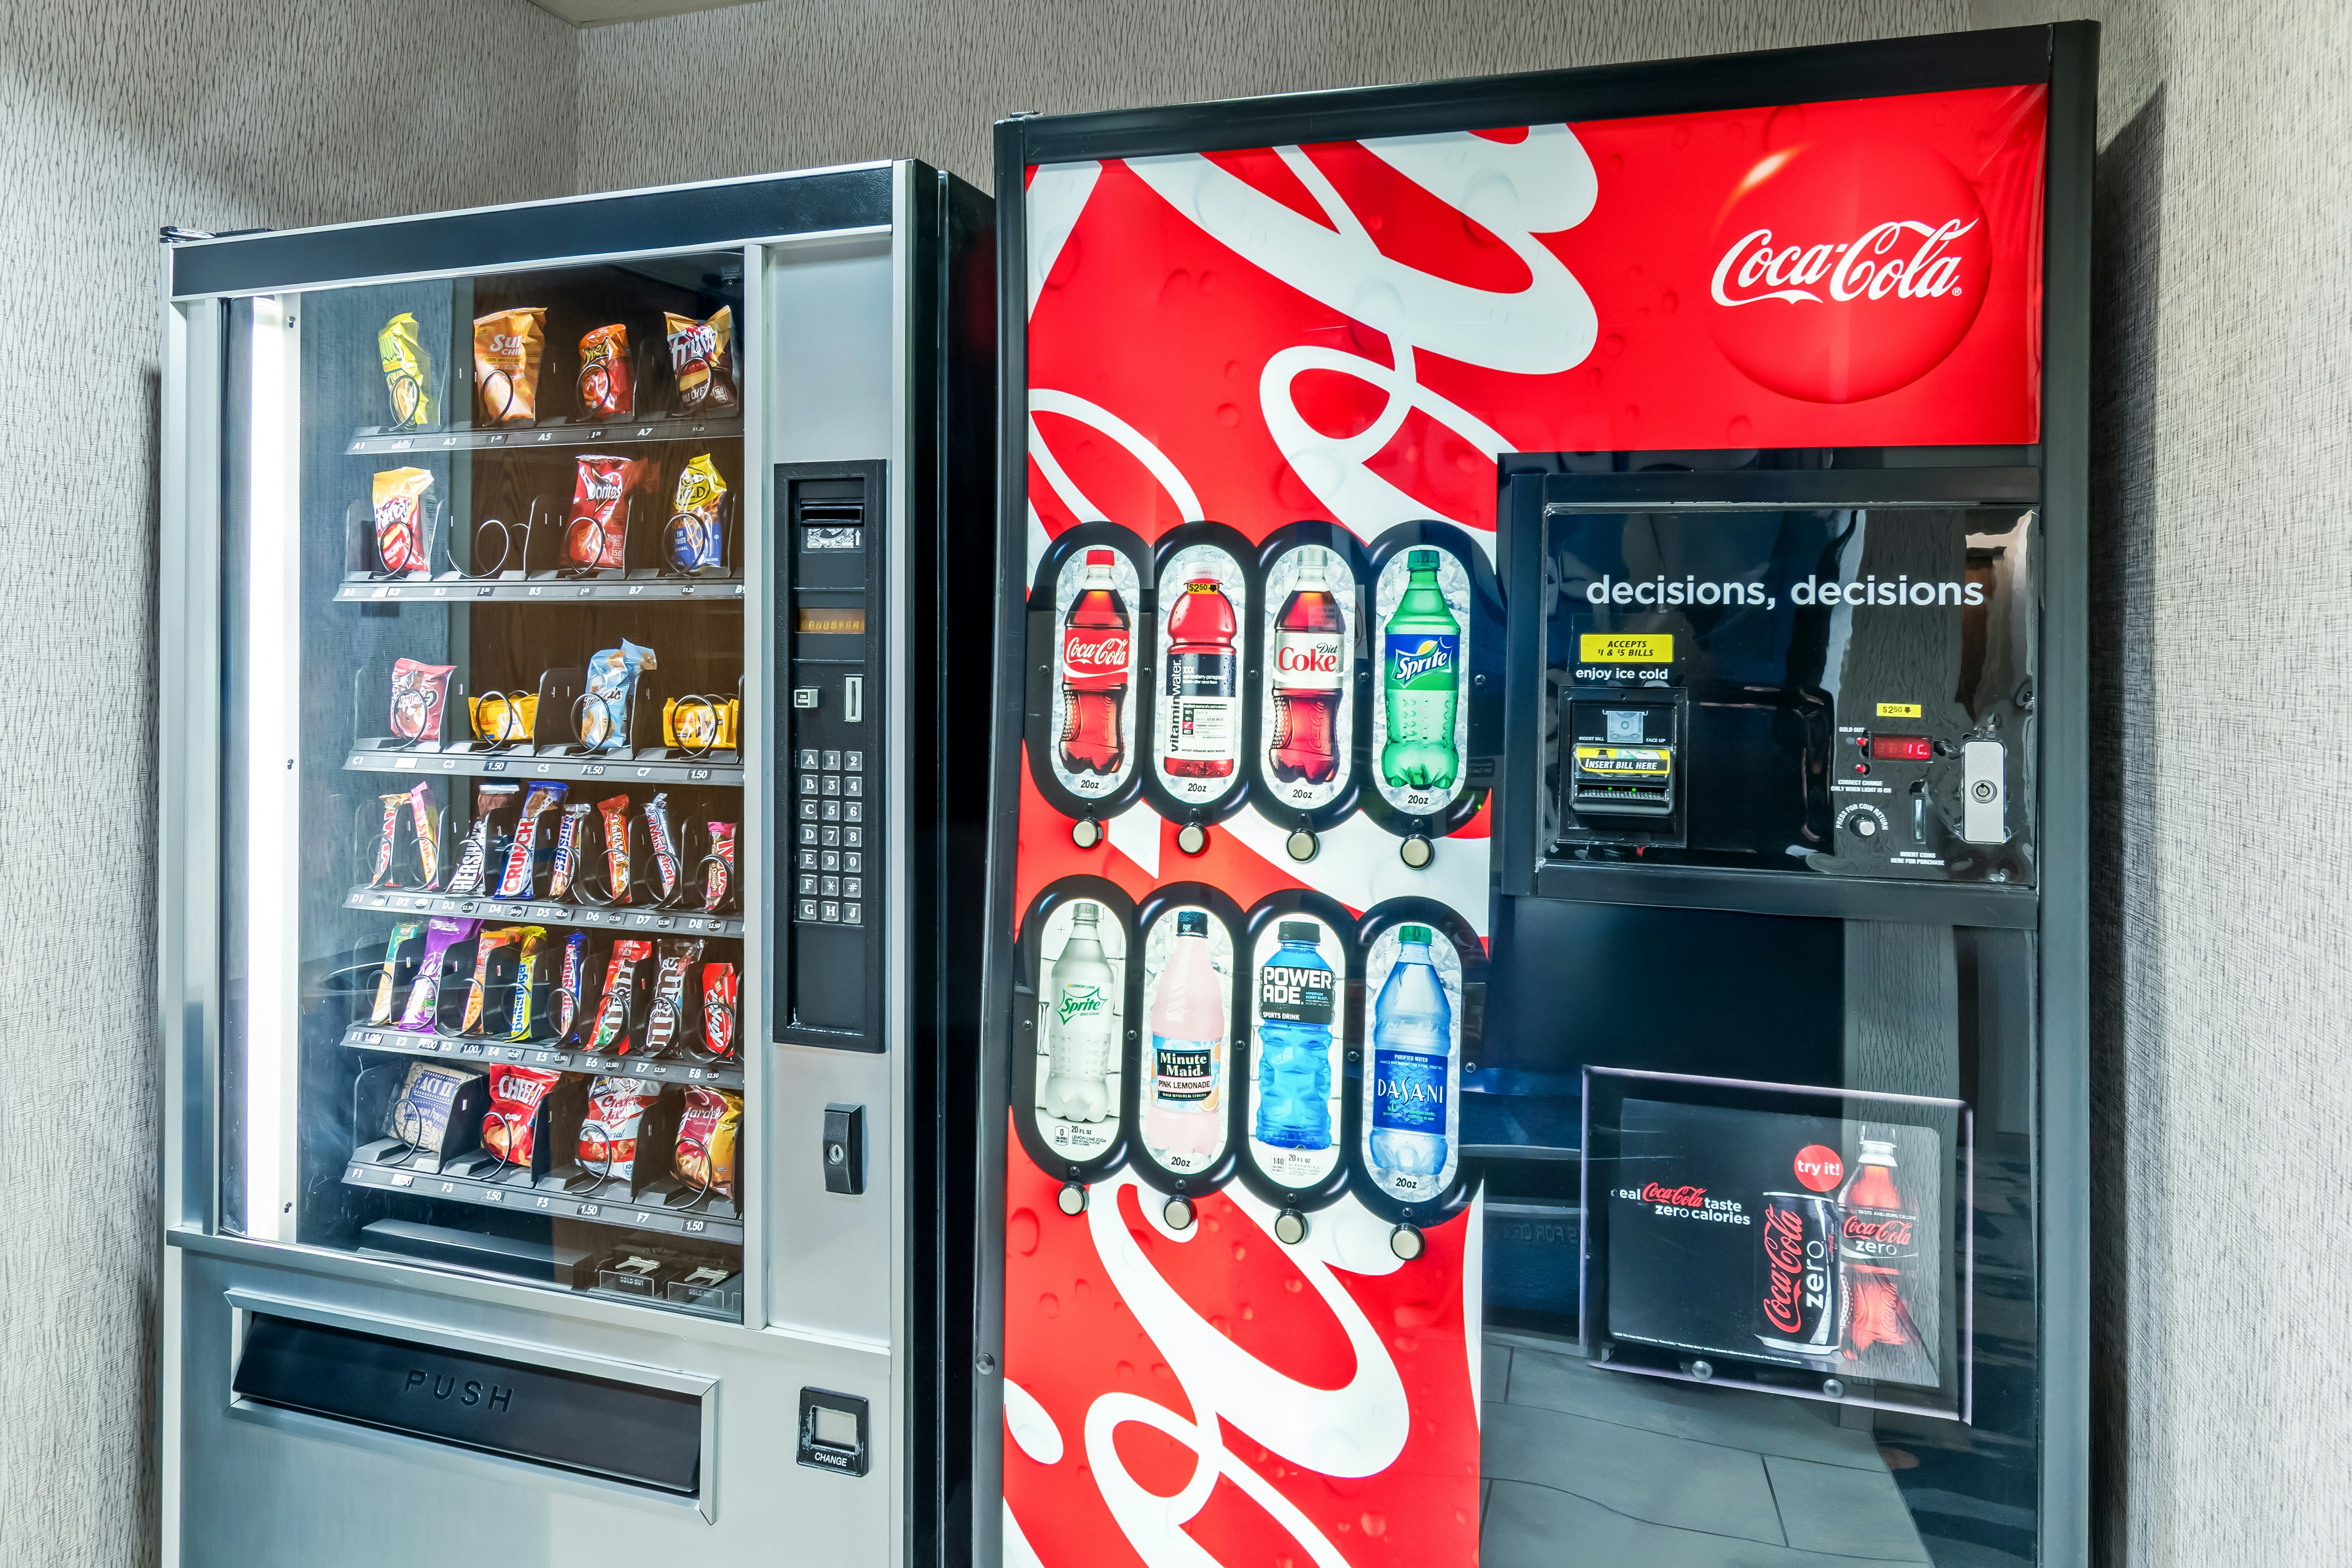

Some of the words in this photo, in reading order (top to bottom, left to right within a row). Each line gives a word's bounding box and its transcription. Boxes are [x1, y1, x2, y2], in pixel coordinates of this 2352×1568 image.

[1711, 218, 1979, 306] Coca-Cola
[529, 587, 542, 596] B5
[629, 586, 644, 594] B7
[1587, 575, 1775, 609] decisions,
[1791, 575, 1984, 606] decisions
[1066, 637, 1128, 666] Coca-Cola
[1316, 642, 1337, 654] Diet
[1396, 649, 1448, 680] Sprite
[1576, 668, 1612, 681] enjoy
[1616, 668, 1635, 679] ice
[1639, 669, 1668, 680] cold
[806, 755, 814, 765] A
[830, 756, 834, 765] 1
[851, 756, 857, 765] 2
[1585, 759, 1612, 769] INSERT
[1616, 761, 1633, 769] BILL
[1635, 762, 1657, 770] HERE
[443, 760, 455, 769] C3
[488, 762, 504, 770] 1.50
[537, 764, 550, 773] C5
[586, 765, 604, 774] 1.50
[637, 768, 651, 776] C7
[691, 770, 708, 779] 1.50
[806, 780, 814, 789] B
[828, 780, 836, 790] 3
[851, 781, 857, 791] 4
[1081, 779, 1099, 789] 20oz
[1187, 783, 1207, 792] 20oz
[1293, 789, 1313, 799] 20oz
[1407, 795, 1429, 806] 20oz
[1836, 811, 1848, 829] PRESS
[1845, 804, 1858, 814] FOR
[1859, 803, 1874, 811] COIN
[1873, 807, 1889, 830] RETURN
[504, 822, 534, 891] CRUNCH
[442, 901, 455, 910] D3
[489, 905, 501, 914] D4
[537, 908, 550, 917] D5
[586, 912, 600, 920] D6
[636, 916, 651, 925] D7
[689, 920, 702, 928] D8
[1264, 966, 1332, 989] POWER
[1061, 998, 1100, 1014] Sprite
[396, 1037, 407, 1046] E2
[441, 1043, 452, 1051] E3
[488, 1048, 499, 1056] E4
[536, 1052, 547, 1062] E5
[586, 1059, 597, 1067] E6
[636, 1063, 649, 1072] E7
[689, 1069, 701, 1078] E8
[1160, 1052, 1207, 1065] Minute
[419, 1076, 441, 1093] ACT
[441, 1082, 455, 1097] II
[1159, 1080, 1171, 1089] PINK
[1173, 1081, 1210, 1089] LEMONADE
[1378, 1076, 1443, 1105] DASANI
[430, 1108, 448, 1125] Popcorn
[1171, 1157, 1190, 1167] 20oz
[1797, 1160, 1821, 1175] try
[1825, 1162, 1840, 1176] it!
[1396, 1178, 1417, 1189] 20oz
[352, 1169, 363, 1178] F1
[441, 1183, 453, 1192] F3
[486, 1191, 502, 1201] 1.50
[537, 1198, 548, 1208] F5
[580, 1205, 598, 1215] 1.50
[636, 1213, 649, 1222] F7
[686, 1220, 703, 1231] 1.50
[1620, 1189, 1641, 1200] eal
[1642, 1182, 1707, 1208] Coca-Cola
[1705, 1198, 1742, 1212] taste
[1655, 1205, 1689, 1217] zero
[1691, 1209, 1750, 1225] calories
[1843, 1216, 1912, 1245] Coca-Cola
[1856, 1240, 1897, 1255] zero
[1764, 1203, 1802, 1333] Coca-Cola
[1806, 1240, 1824, 1309] zero
[404, 1369, 514, 1413] PUSH
[815, 1452, 847, 1466] CHANGE
